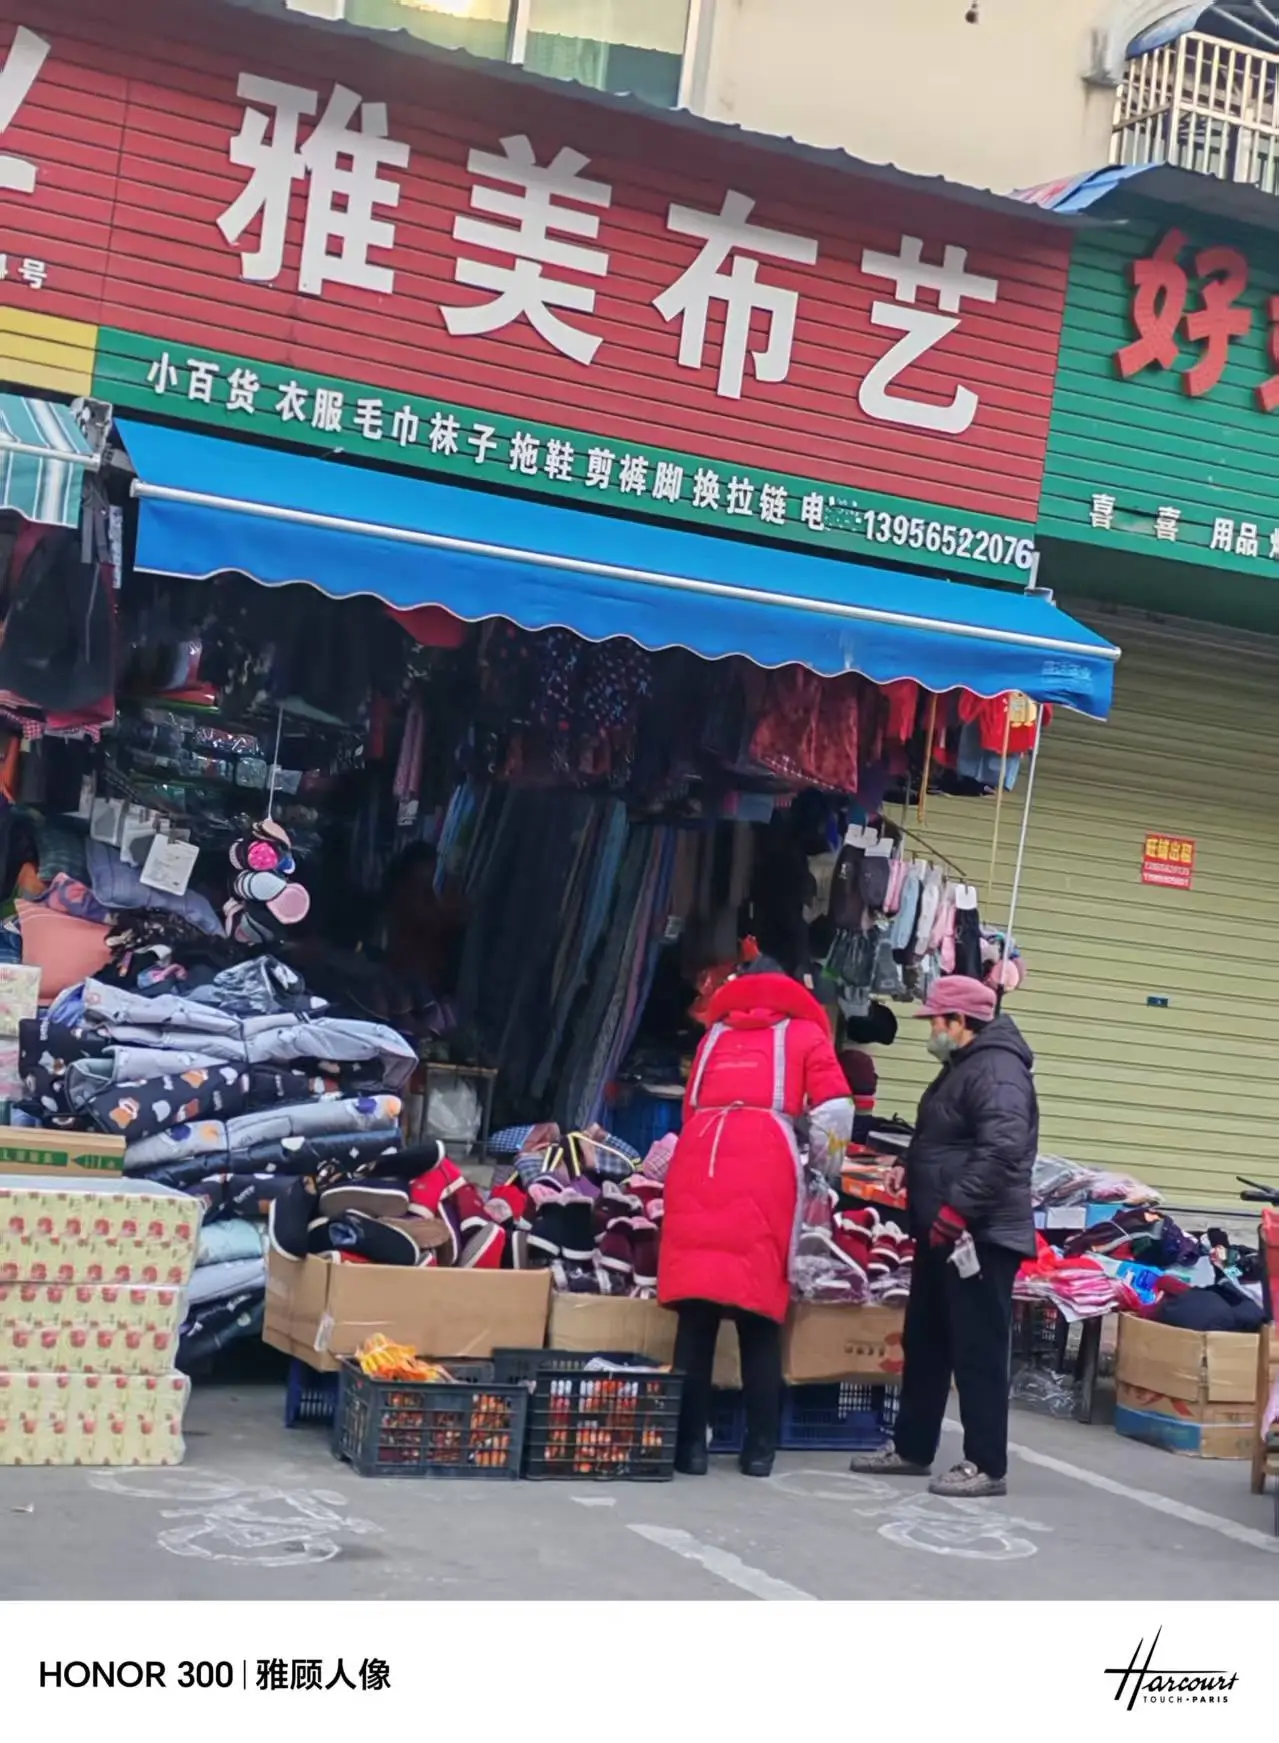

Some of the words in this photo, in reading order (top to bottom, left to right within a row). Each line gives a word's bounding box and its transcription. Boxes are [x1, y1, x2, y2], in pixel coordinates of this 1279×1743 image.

[217, 72, 999, 435] 雅美布艺
[1113, 226, 1279, 414] 好
[146, 351, 260, 414] 小百货
[275, 380, 344, 432] 衣服
[352, 398, 419, 447] 毛巾
[428, 412, 498, 464] 袜子
[508, 431, 575, 483] 拖鞋
[584, 447, 684, 504] 剪裤脚
[691, 467, 791, 525] 换拉链
[863, 509, 1035, 570] 13956522076
[1089, 493, 1116, 530] 喜
[1153, 505, 1181, 542] 喜
[1210, 517, 1258, 558] 用品
